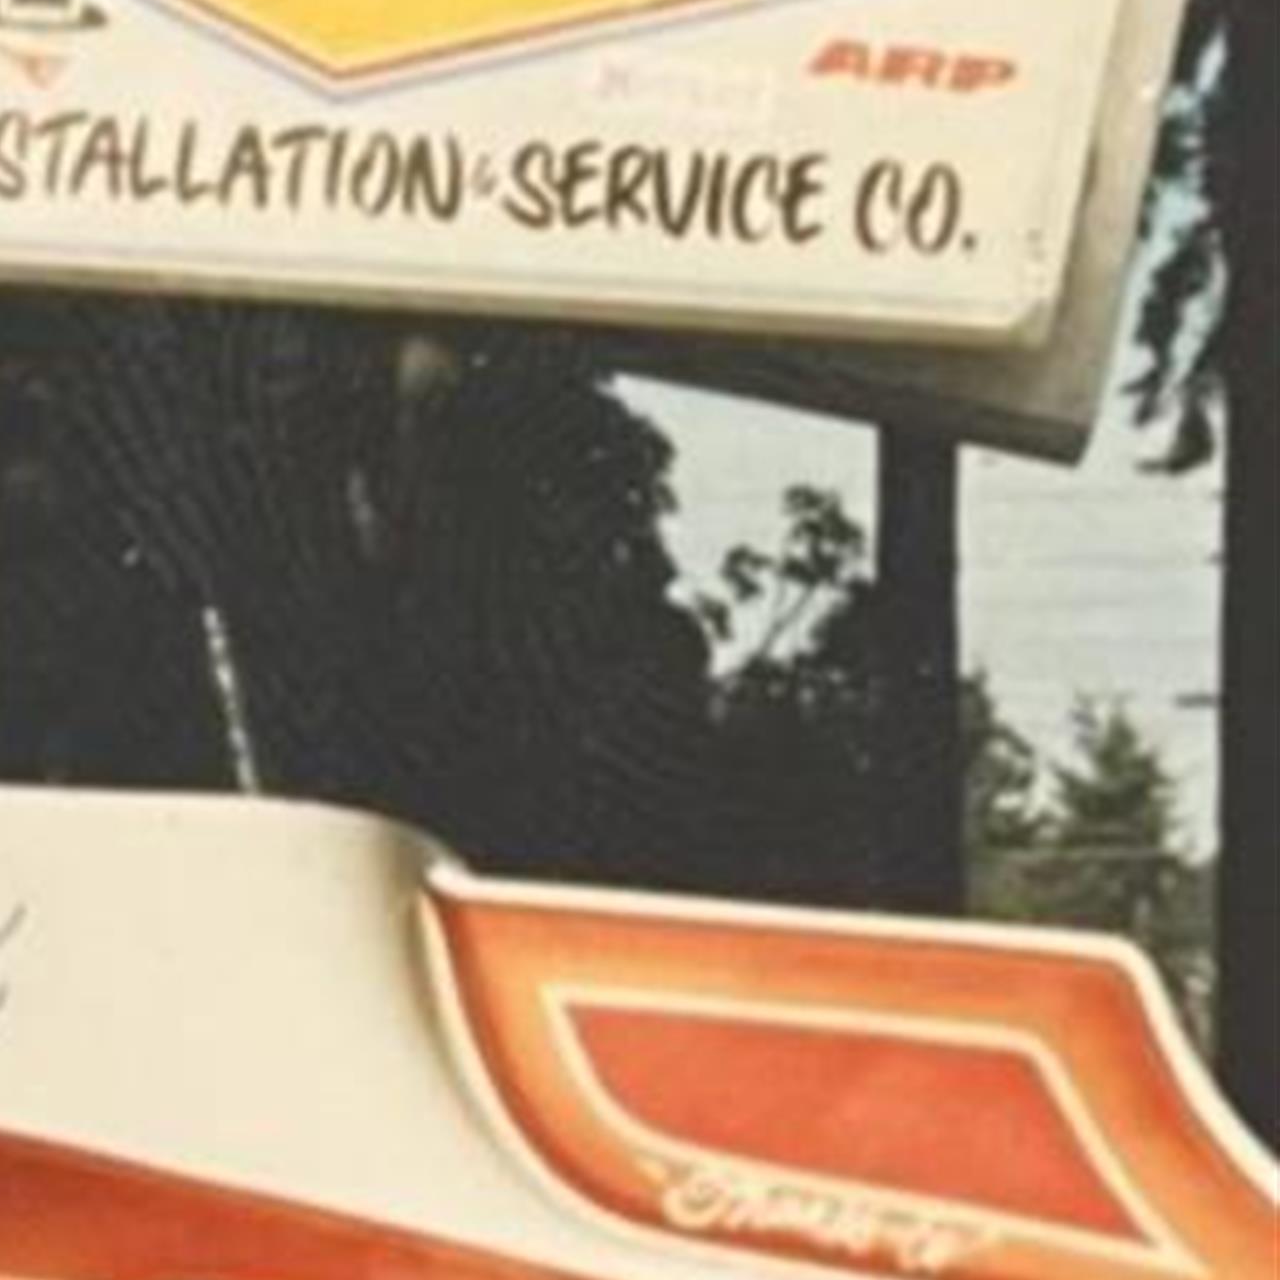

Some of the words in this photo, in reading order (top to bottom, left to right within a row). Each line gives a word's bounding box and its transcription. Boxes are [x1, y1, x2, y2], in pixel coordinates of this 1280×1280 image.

[807, 39, 1018, 94] ARP
[502, 140, 827, 244] SERVICE
[854, 158, 978, 255] CO.
